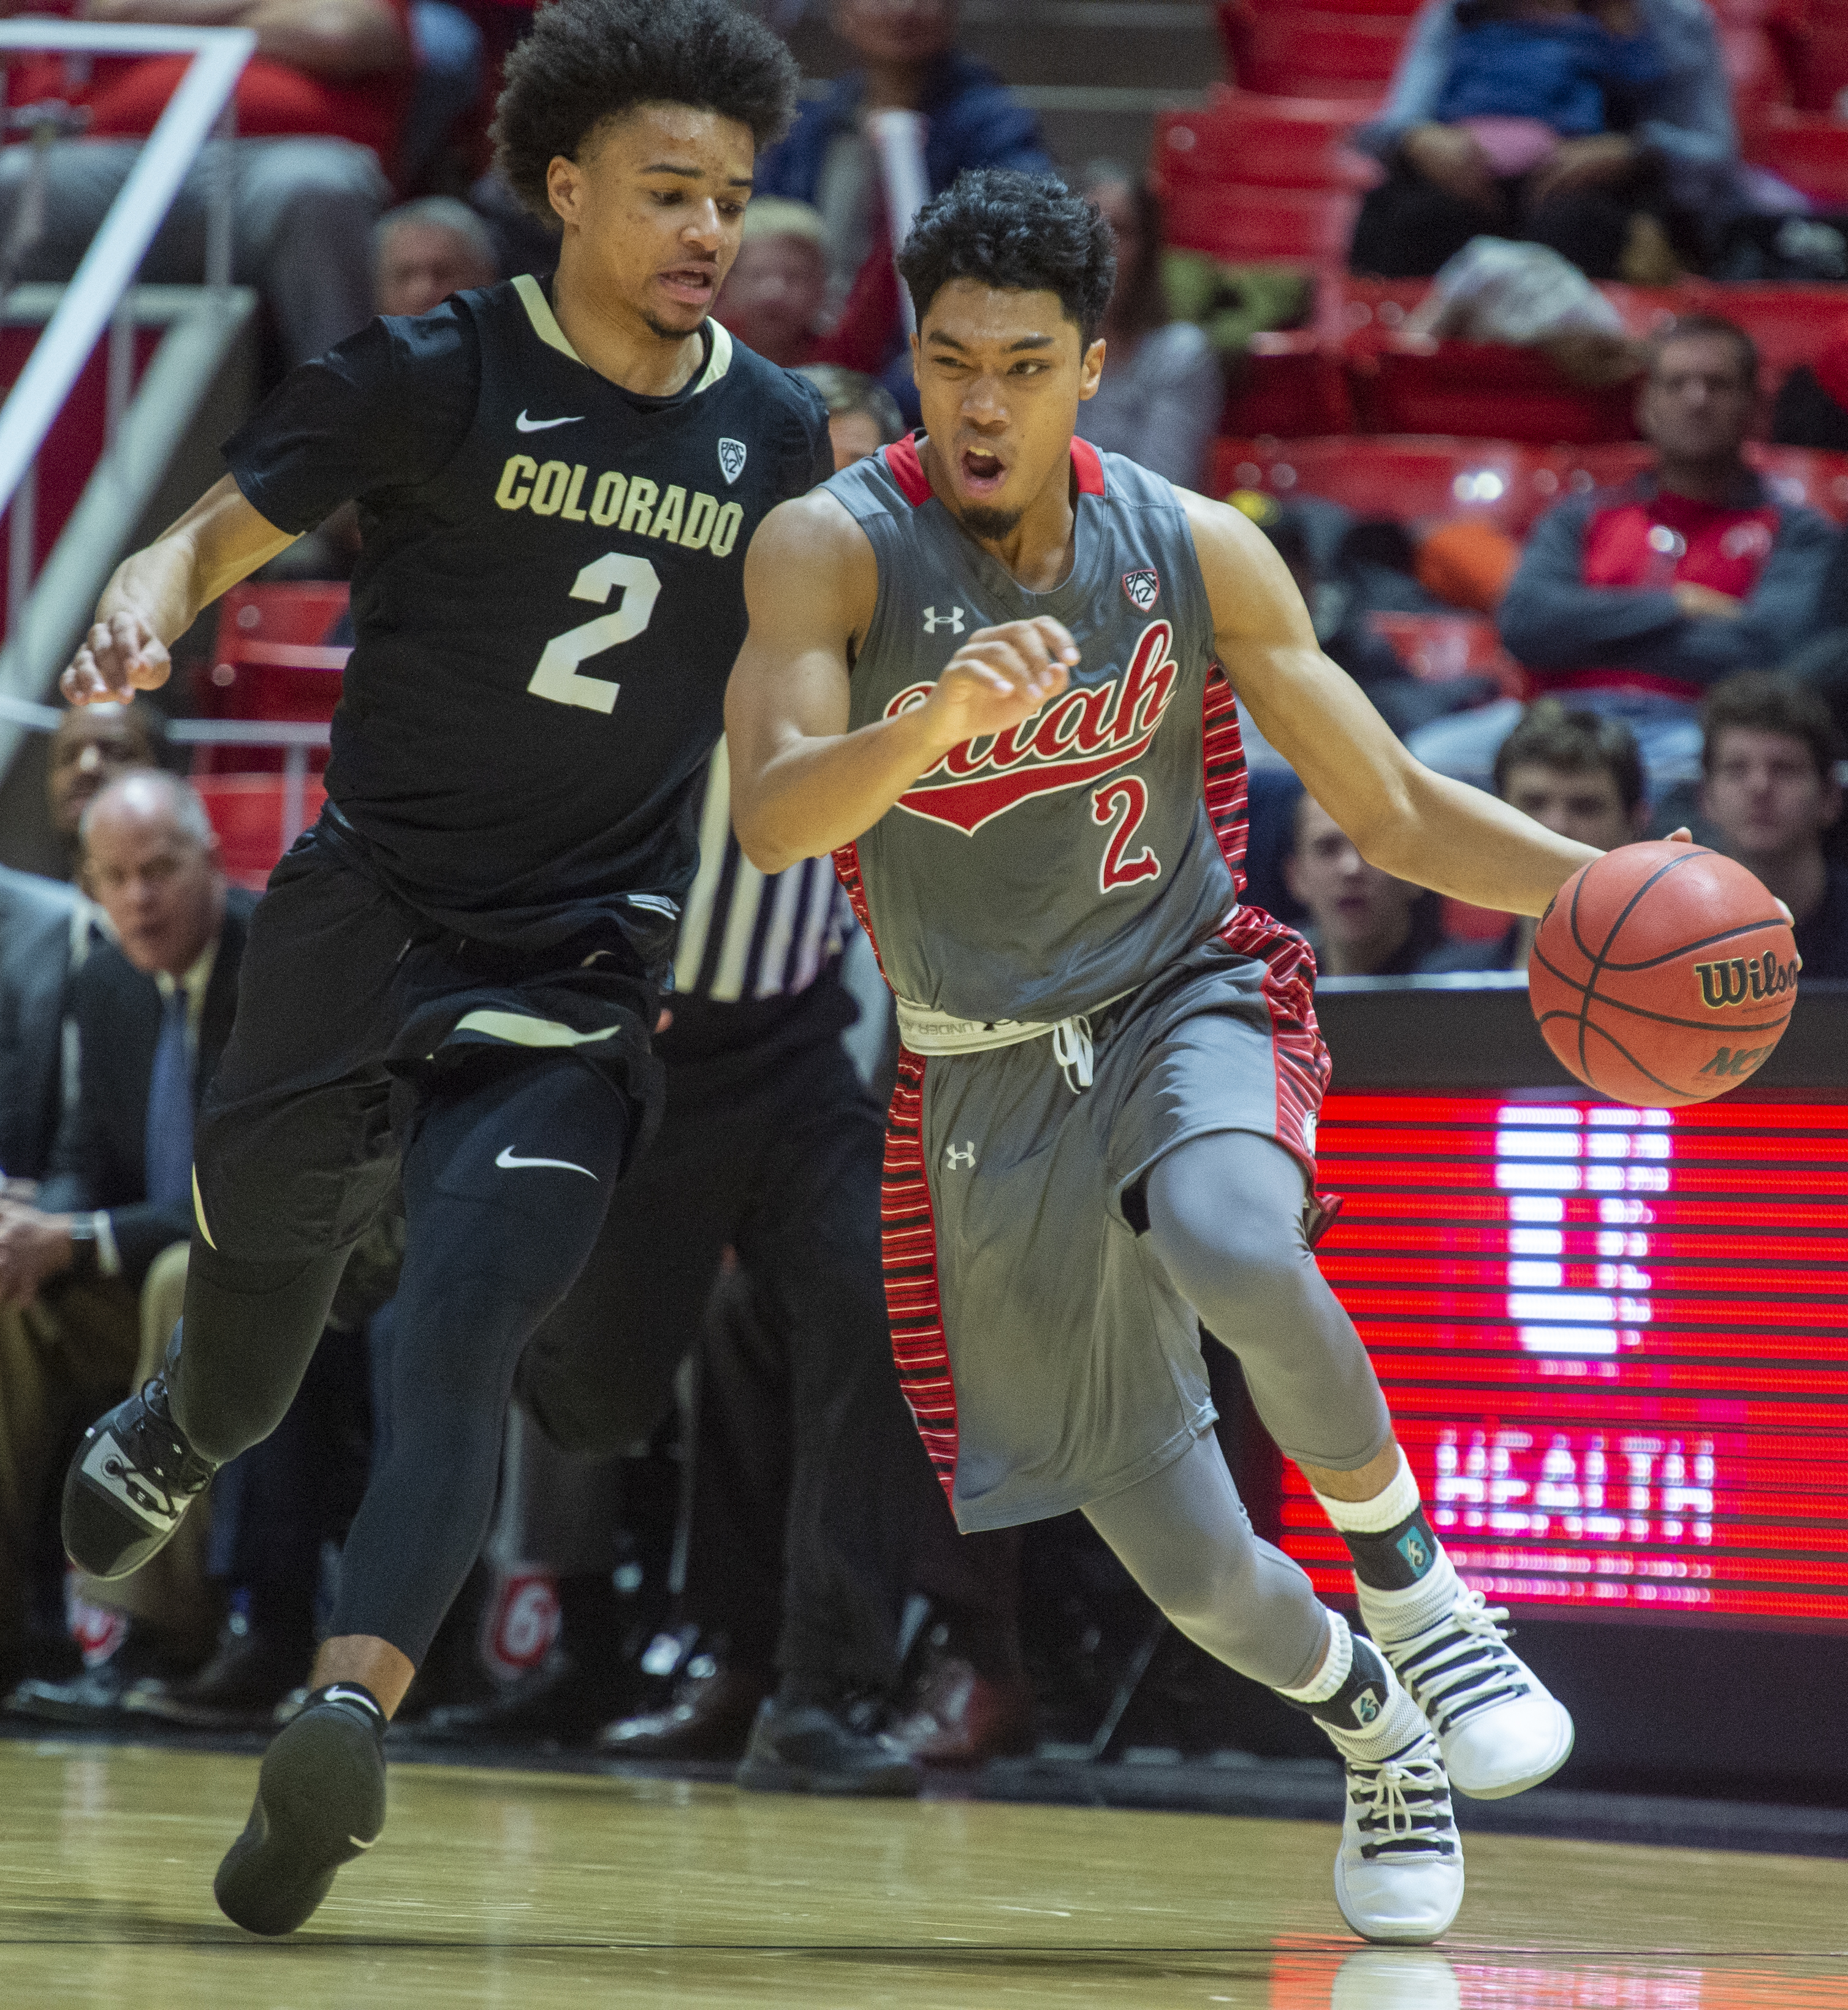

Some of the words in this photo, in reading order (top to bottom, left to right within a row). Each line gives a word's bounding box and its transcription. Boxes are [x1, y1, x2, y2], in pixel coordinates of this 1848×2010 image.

[494, 453, 744, 558] COLORADO
[527, 552, 663, 715] 2
[1135, 586, 1154, 604] 12
[1091, 775, 1162, 894] 2
[1434, 1429, 1714, 1544] HEALTH
